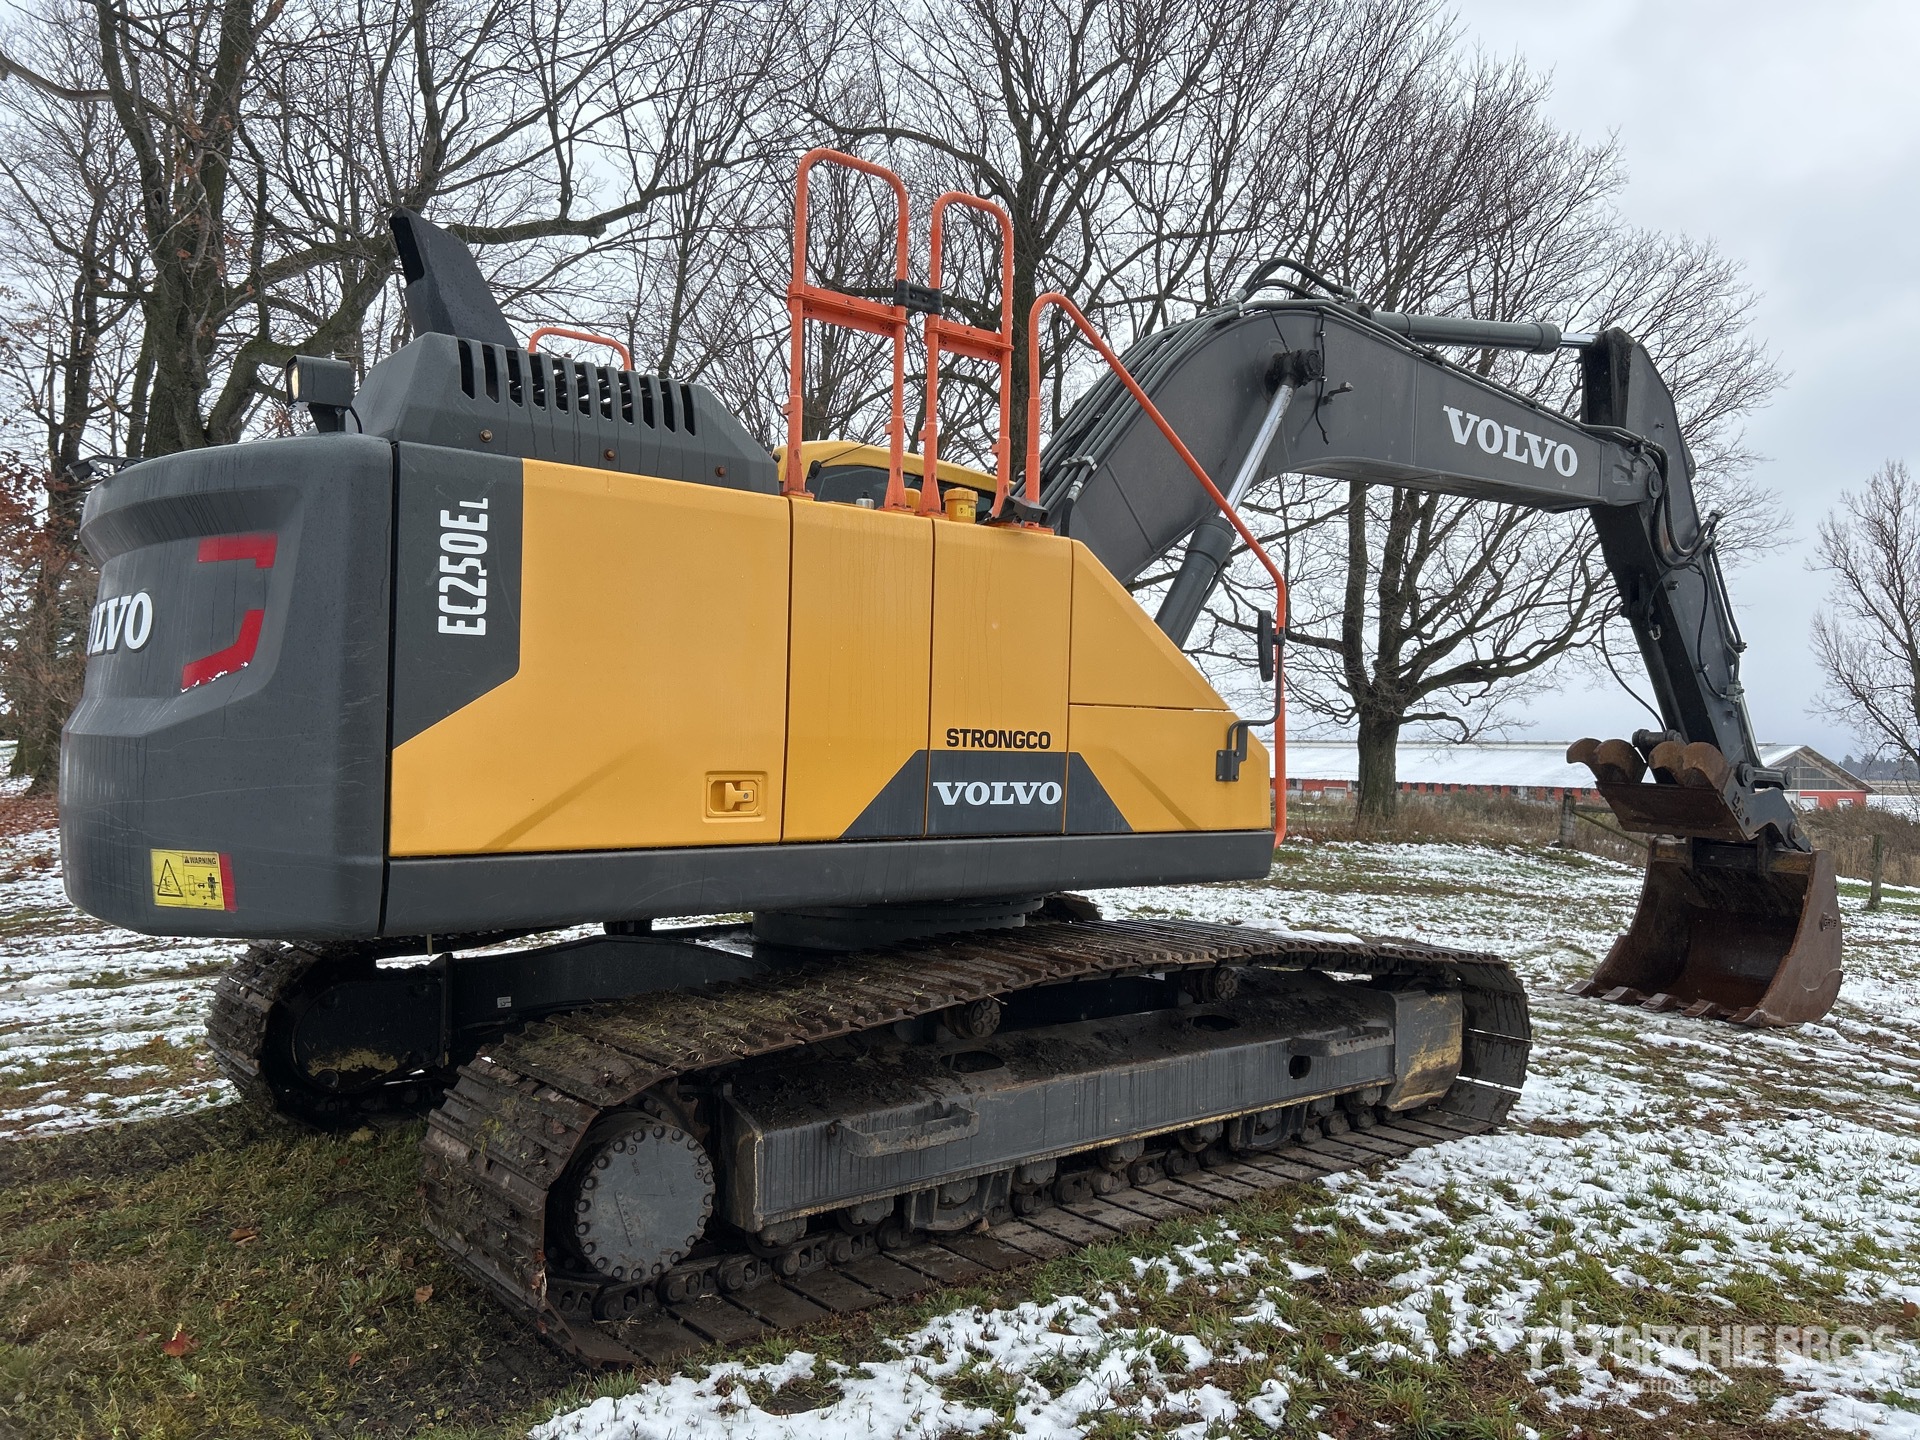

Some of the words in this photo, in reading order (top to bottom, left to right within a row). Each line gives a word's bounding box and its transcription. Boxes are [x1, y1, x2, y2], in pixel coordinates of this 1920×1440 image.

[1443, 405, 1578, 477] VOLVO
[438, 498, 488, 636] EC250EL
[86, 592, 153, 657] OLVO
[946, 728, 1051, 749] STRONGCO
[932, 781, 1062, 806] VOLVO
[189, 856, 217, 865] WARNING
